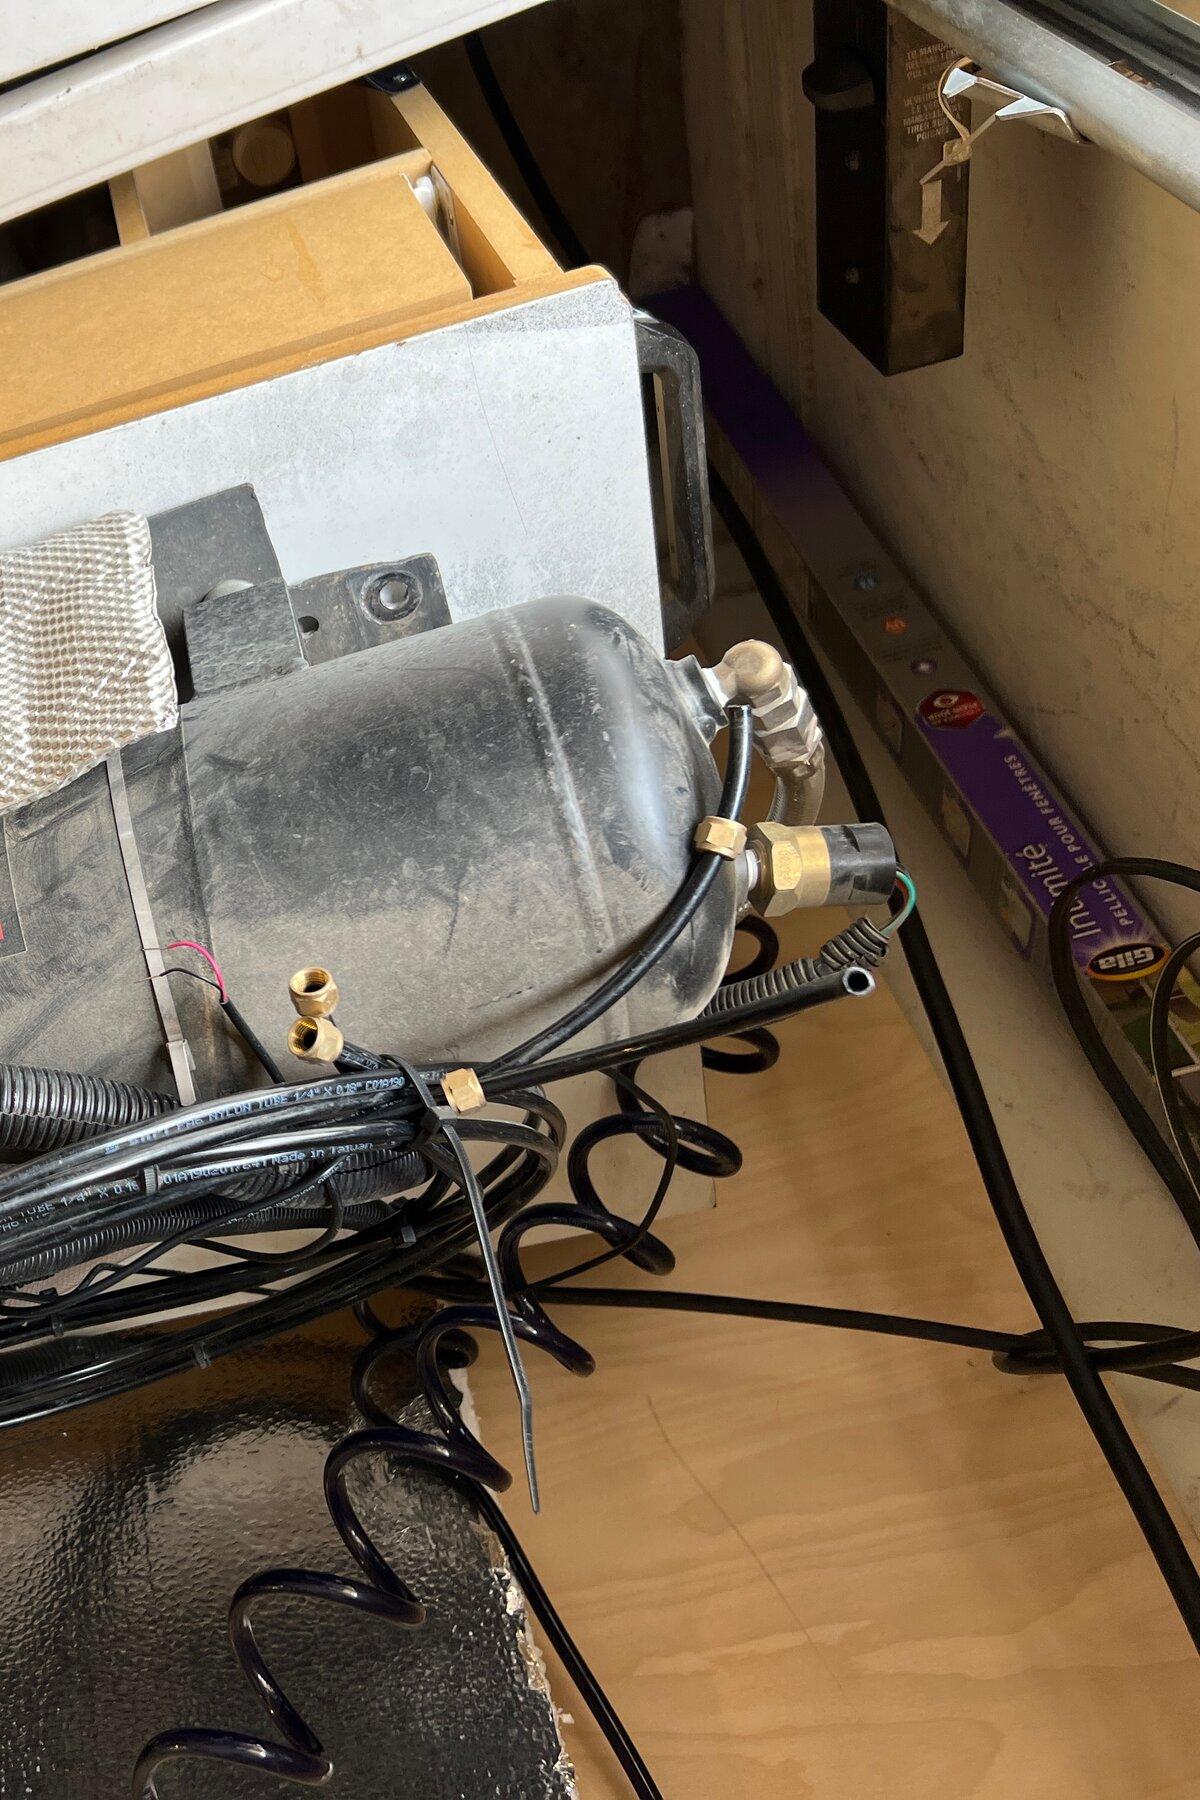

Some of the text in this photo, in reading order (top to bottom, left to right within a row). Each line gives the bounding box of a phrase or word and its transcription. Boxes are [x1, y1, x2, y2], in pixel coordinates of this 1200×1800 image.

[1047, 815, 1081, 853] POUR
[1074, 852, 1134, 927] PELLICLE
[1098, 946, 1154, 970] Gila
[208, 1103, 253, 1122] NYLON
[258, 1095, 288, 1110] TUBE
[324, 1085, 333, 1096] X
[97, 1187, 109, 1199] X
[271, 1151, 306, 1166] Made
[310, 1147, 325, 1159] in
[330, 1141, 373, 1155] Taiwan
